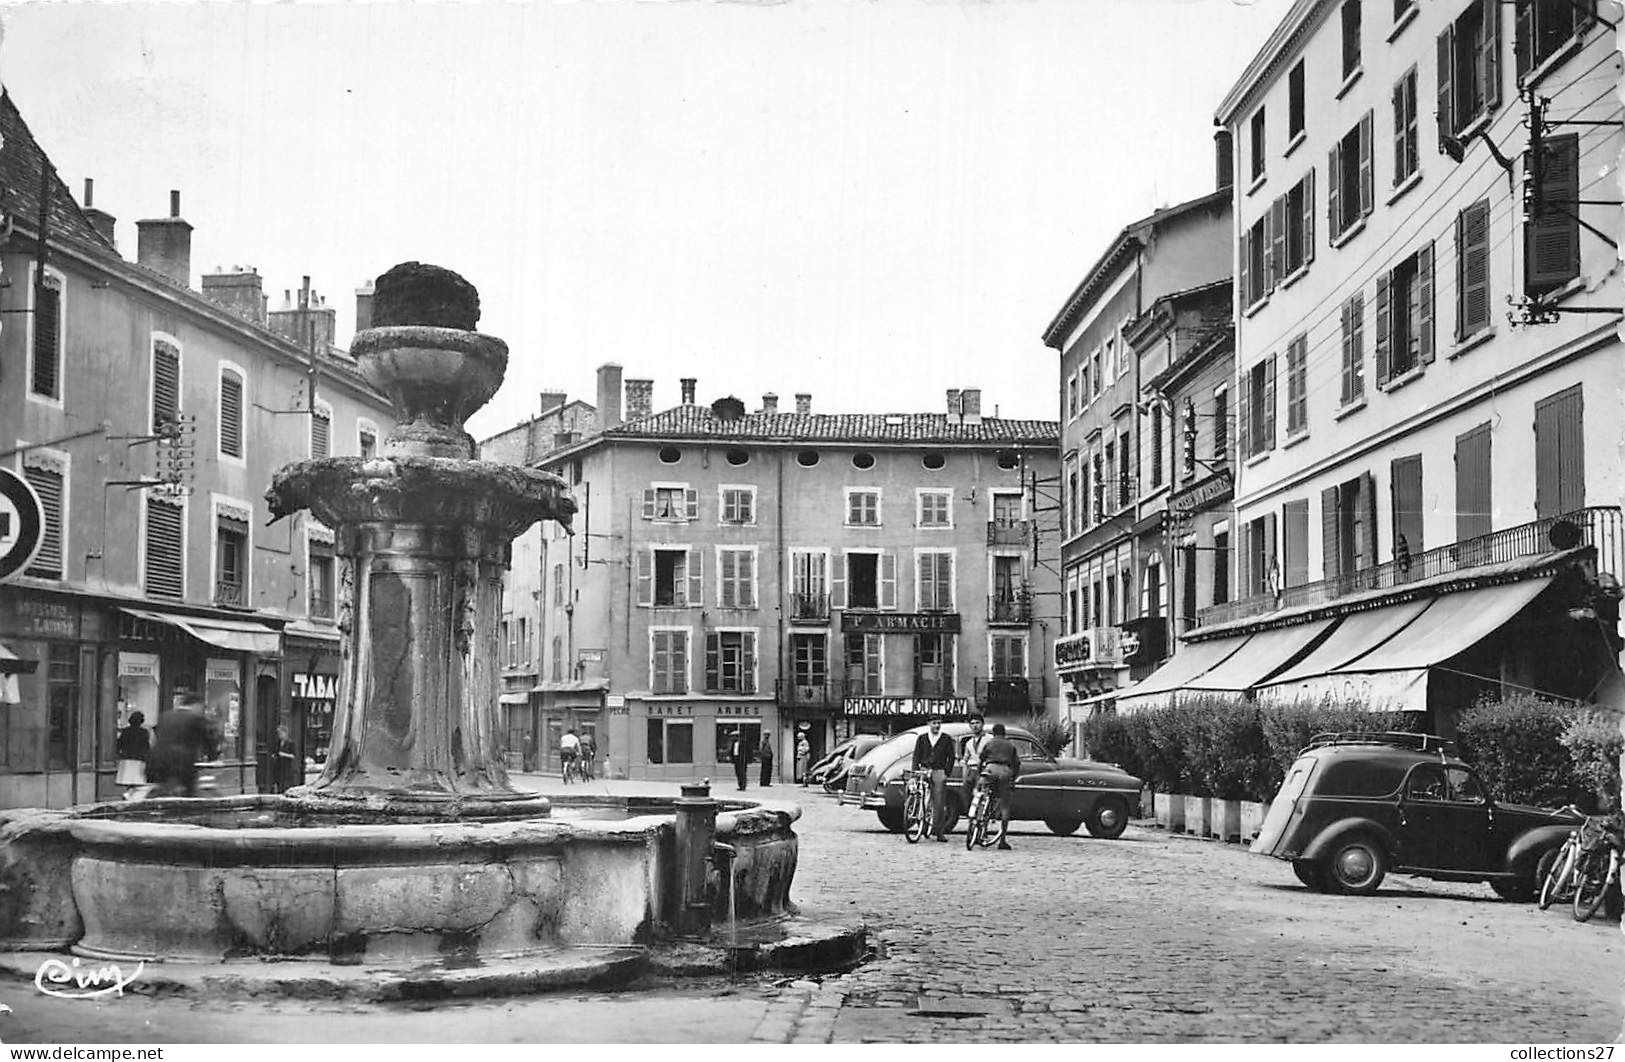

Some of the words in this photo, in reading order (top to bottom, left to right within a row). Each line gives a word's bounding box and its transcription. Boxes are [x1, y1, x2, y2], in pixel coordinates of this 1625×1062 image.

[854, 616, 946, 628] PARMACIE
[716, 705, 760, 716] ARMES
[844, 698, 906, 715] PHARMACIE
[911, 698, 966, 715] JOUFFRAY
